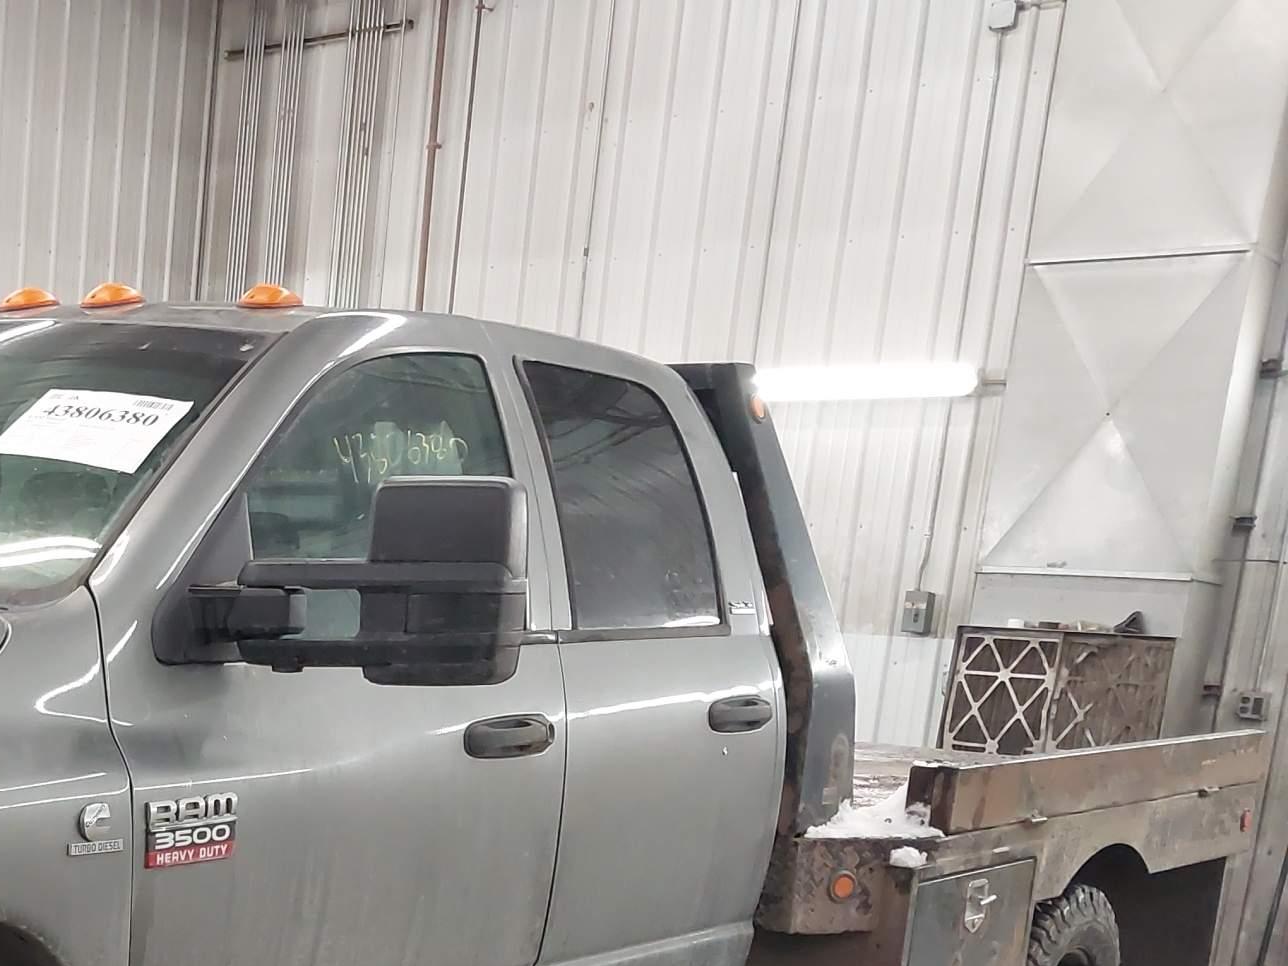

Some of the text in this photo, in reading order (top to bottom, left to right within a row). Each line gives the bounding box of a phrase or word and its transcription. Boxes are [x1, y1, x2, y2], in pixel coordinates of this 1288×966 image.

[43, 404, 160, 426] 43806380
[148, 792, 239, 823] RAM
[155, 825, 230, 850] 3500
[156, 844, 228, 865] HEAVY DUTY
